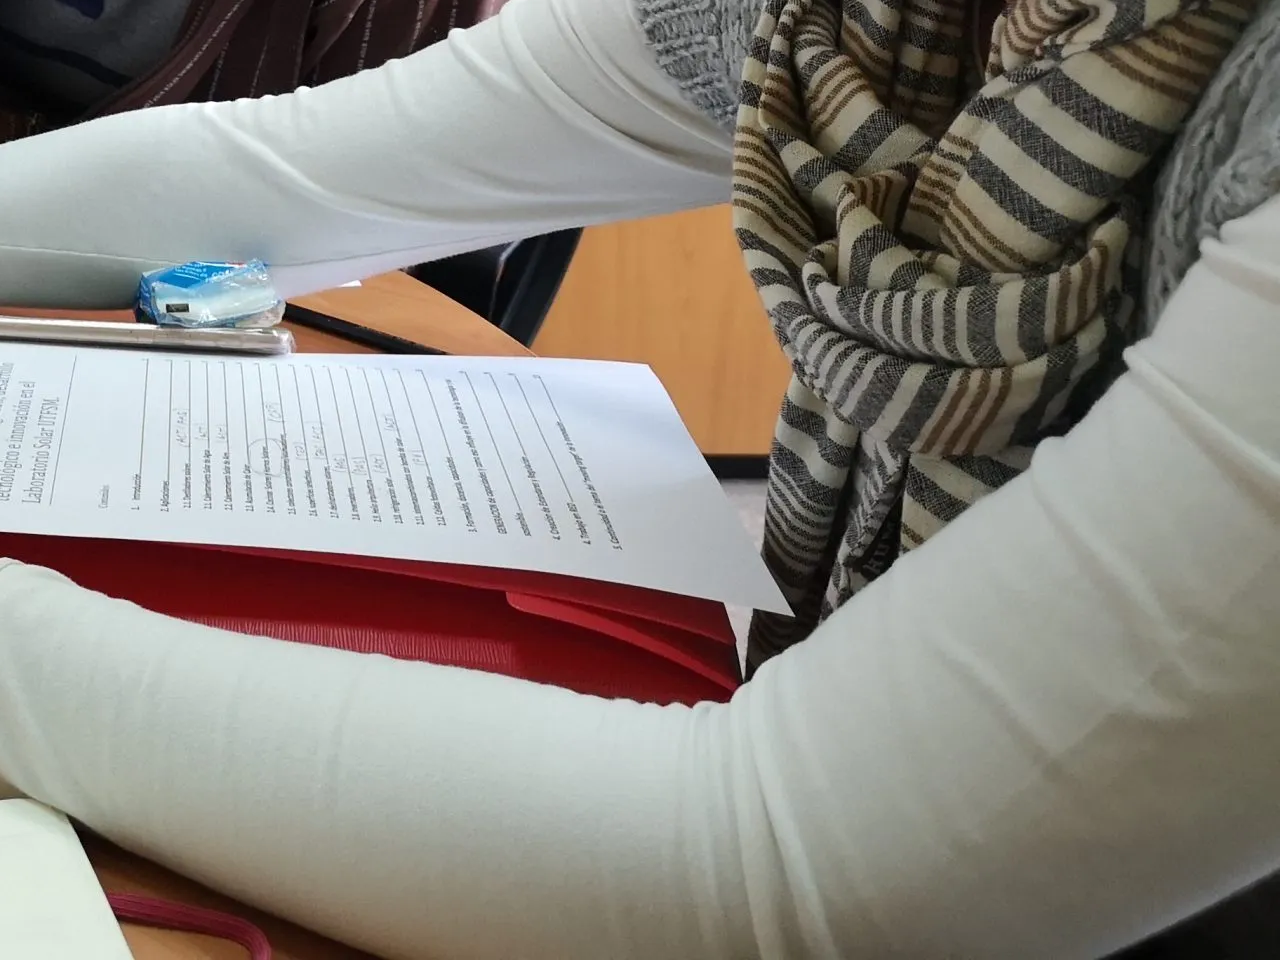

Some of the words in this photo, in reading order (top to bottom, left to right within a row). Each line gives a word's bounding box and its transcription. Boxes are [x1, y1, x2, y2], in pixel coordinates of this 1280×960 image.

[17, 379, 35, 388] el
[18, 387, 33, 399] en
[5, 397, 31, 442] innovación
[37, 394, 60, 426] UTFSM.
[32, 426, 54, 448] Solar
[21, 450, 50, 503] Laboratorio
